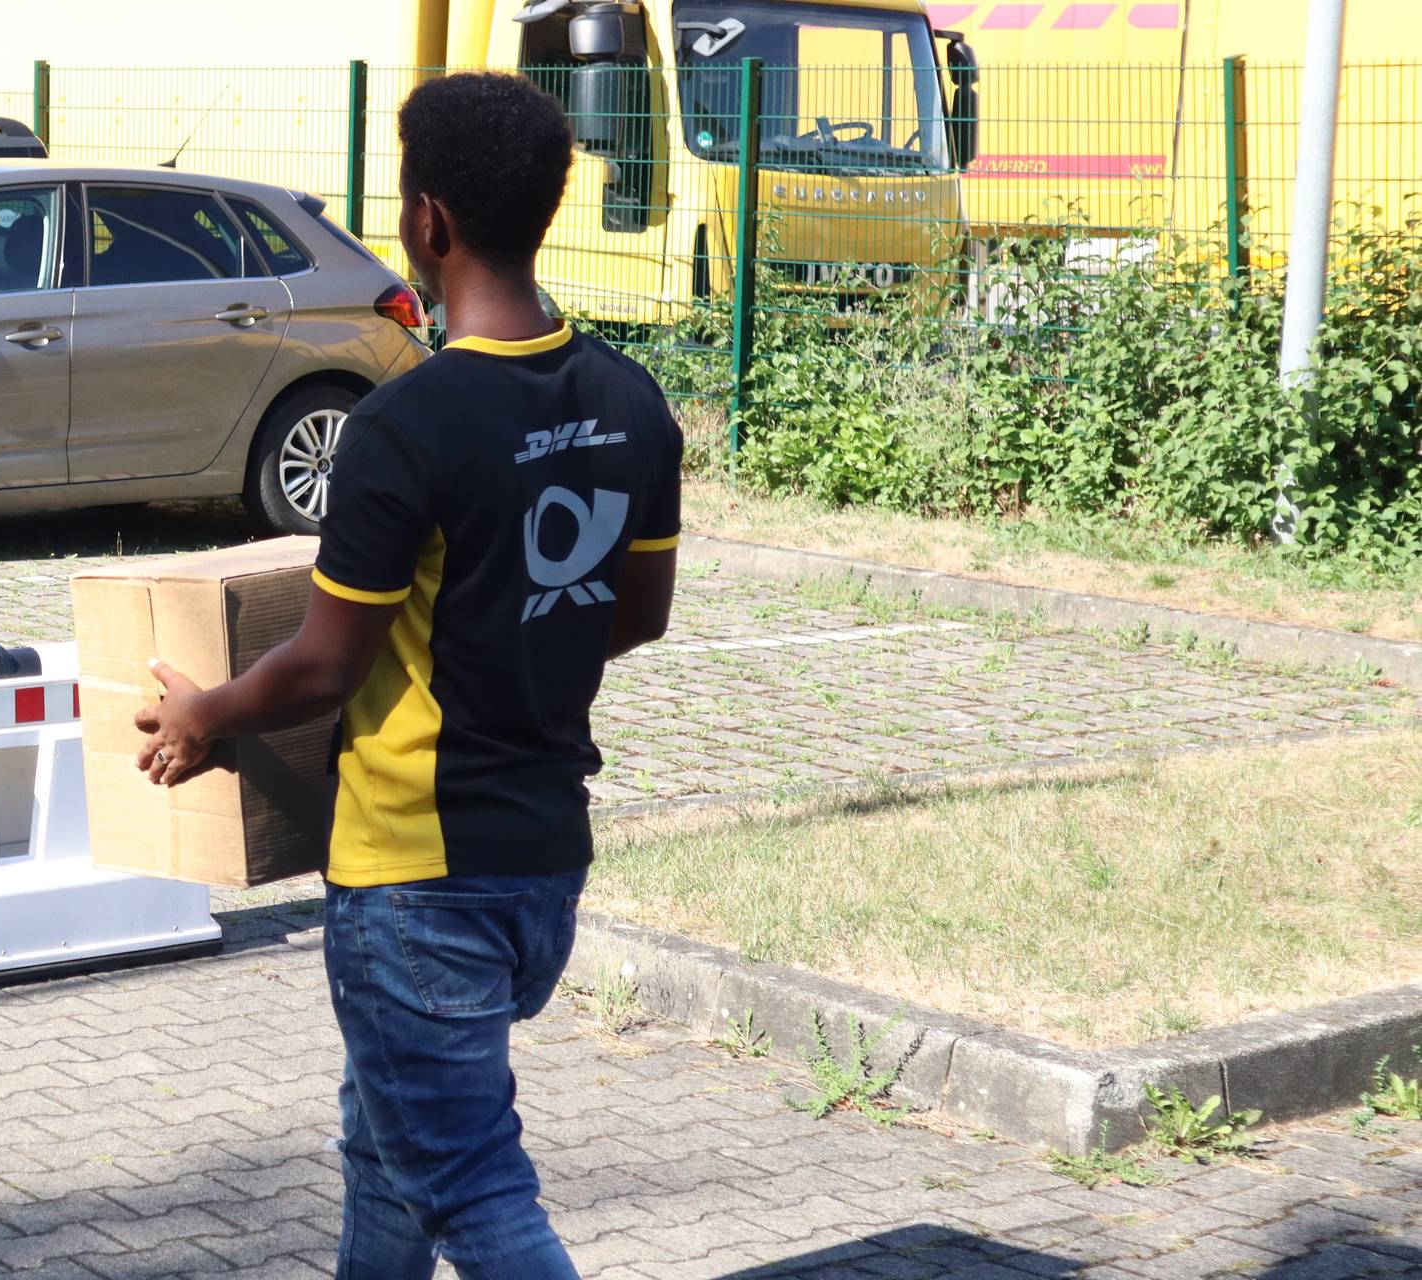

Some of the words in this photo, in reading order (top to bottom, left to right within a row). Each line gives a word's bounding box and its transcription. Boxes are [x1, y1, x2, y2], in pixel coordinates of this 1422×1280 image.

[967, 159, 1048, 173] ELIVERED
[773, 183, 926, 202] EUROCARGO
[523, 418, 609, 460] DHL
